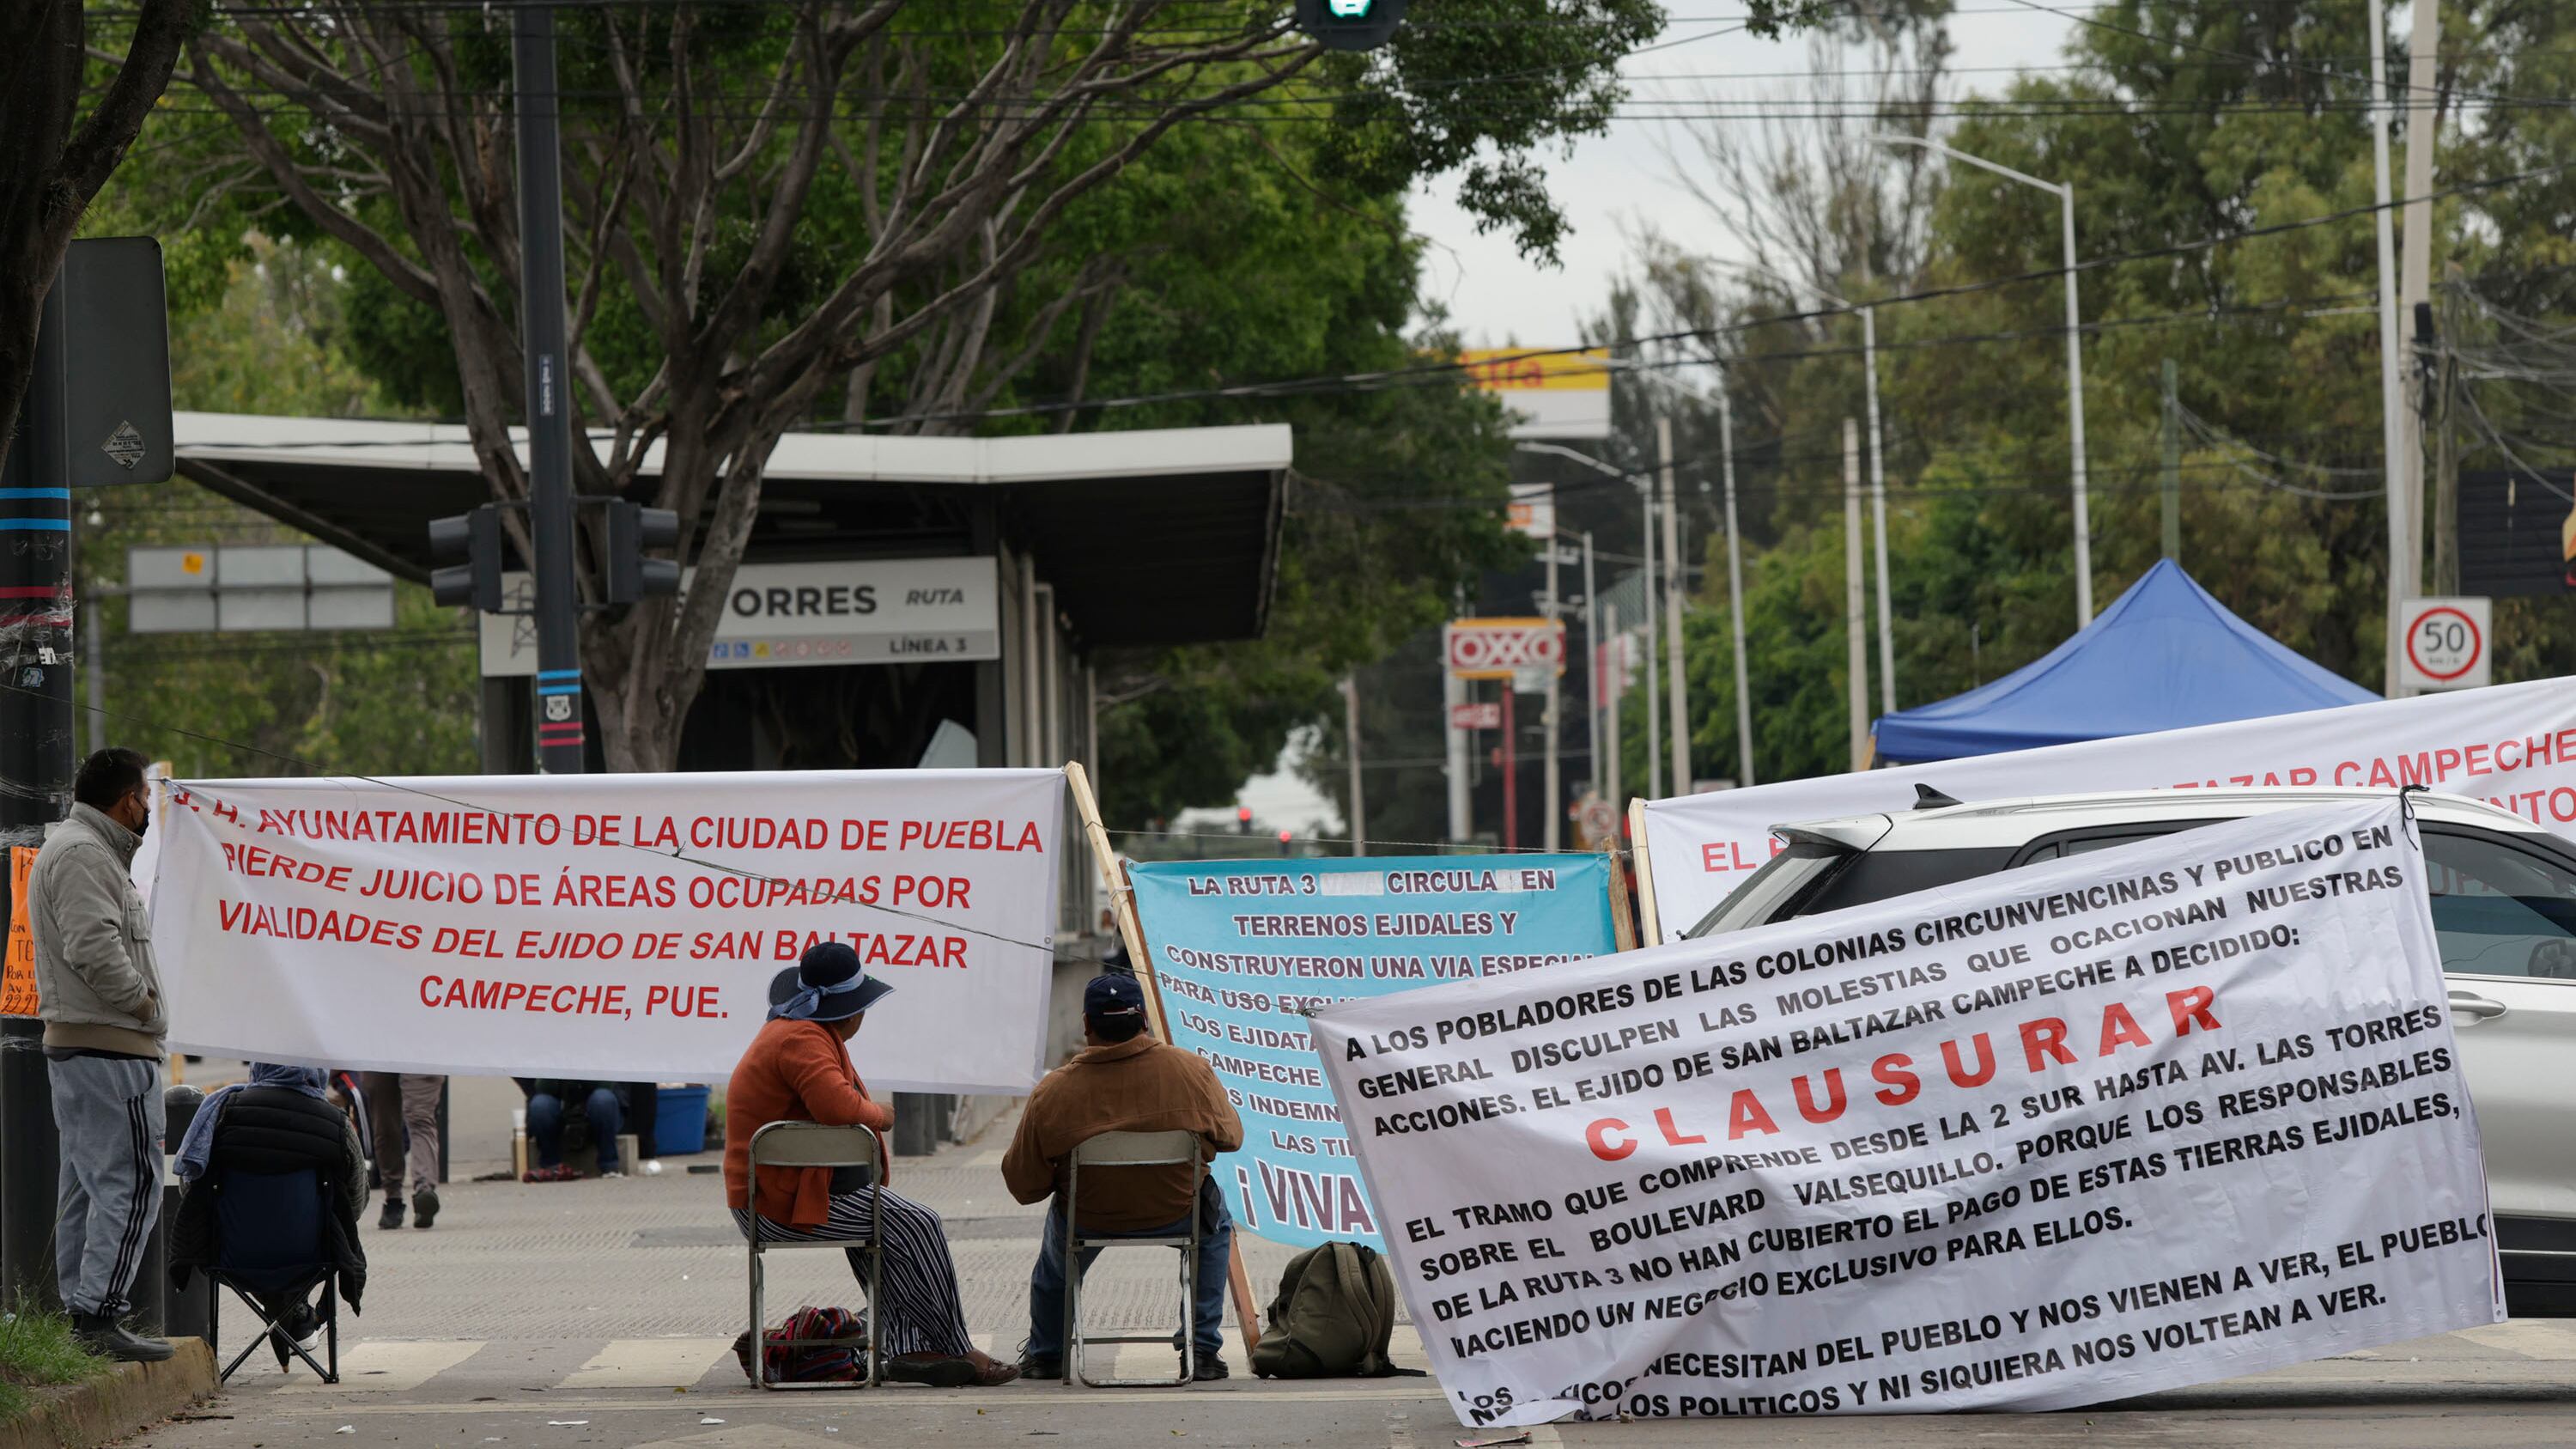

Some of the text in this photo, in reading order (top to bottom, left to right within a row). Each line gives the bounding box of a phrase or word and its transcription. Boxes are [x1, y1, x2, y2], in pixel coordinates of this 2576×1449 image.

[731, 587, 965, 617] ORRES RUTA
[890, 638, 968, 655] LÍNEA 3
[1455, 633, 1561, 667] OXXO
[2425, 622, 2464, 652] 50
[212, 799, 246, 828] H.
[258, 809, 560, 845] AYUNATAMIENTO
[574, 814, 621, 846] DE
[634, 816, 678, 847] LA
[690, 816, 829, 849] CIUDAD
[841, 819, 889, 851] DE
[900, 819, 1043, 853] PUEBLA
[222, 842, 971, 909] PIERDE JUICIO DE ÁREAS OCUPADAS POR
[1188, 870, 1554, 896] LA RUTA 3 CIRCULA EN
[1702, 841, 1756, 872] EL
[218, 900, 422, 949] VIALIDADES
[432, 928, 503, 958] DEL
[516, 931, 623, 959] EJIDO
[632, 933, 683, 959] DE
[690, 930, 763, 959] SAN
[1233, 912, 1517, 936] TERRENOS EJIDALES Y
[1346, 825, 2393, 1062] A LOS POBLADORES DE LAS COLONIAS CIRCUNVENCINAS Y PUBLICO EN
[1166, 946, 1364, 977] CONSTRUYERON
[1371, 956, 1425, 978] UNA
[1430, 955, 1474, 977] VIA
[1358, 1058, 1492, 1099] GENERAL
[1510, 1019, 1680, 1074] DISCULPEN
[1699, 1002, 1757, 1032] LAS
[1777, 962, 1947, 1016] MOLESTIAS
[1967, 945, 2031, 973] QUE
[2050, 897, 2227, 955] OCACIONAN
[2246, 865, 2403, 913] NUESTRAS
[419, 975, 728, 1020] CAMPECHE, PUE.
[1160, 972, 1216, 1004] PARA
[1221, 990, 1270, 1012] USO
[1181, 1011, 1221, 1037] LOS
[1375, 923, 2300, 1136] ACCIONES. EL EJIDO DE SAN BALTAZAR CAMPECHE A DECIDIDO:
[1585, 985, 2222, 1161] CLAUSURAR
[1272, 1131, 1316, 1154] LAS
[1406, 1005, 2441, 1242] EL TRAMO QUE COMPRENDE DESDE LA 2 SUR HASTA AV. LAS TORRES
[1421, 1047, 2451, 1281] SOBRE EL BOULEVARD VALSEQUILLO. PORQUE LOS RESPONSABLES
[1432, 1093, 2459, 1321] DE LA RUTA 3 NO HAN CUBIERTO EL PAGO DE ESTAS TIERRAS EJIDALES,
[1596, 1302, 1635, 1328] UN
[1777, 1245, 1936, 1296] EXCLUSIVO
[1947, 1228, 2026, 1261] PARA
[2033, 1206, 2133, 1247] ELLOS.
[1816, 1336, 1874, 1367] DEL
[1881, 1315, 2002, 1355] PUEBLO
[2010, 1309, 2030, 1334] Y
[2039, 1294, 2101, 1329] NOS
[2108, 1270, 2223, 1312] VIENEN
[2233, 1266, 2254, 1291] A
[2259, 1251, 2330, 1278] VER,
[2336, 1241, 2373, 1269] EL
[1680, 1386, 1840, 1416] POLITICOS
[1848, 1381, 1868, 1405] Y
[1880, 1374, 1910, 1402] NI
[1921, 1349, 2065, 1391] SIQUIERA
[2073, 1335, 2136, 1367] NOS
[2142, 1305, 2281, 1352] VOLTEAN
[2291, 1299, 2312, 1324] A
[2318, 1282, 2386, 1316] VER.
